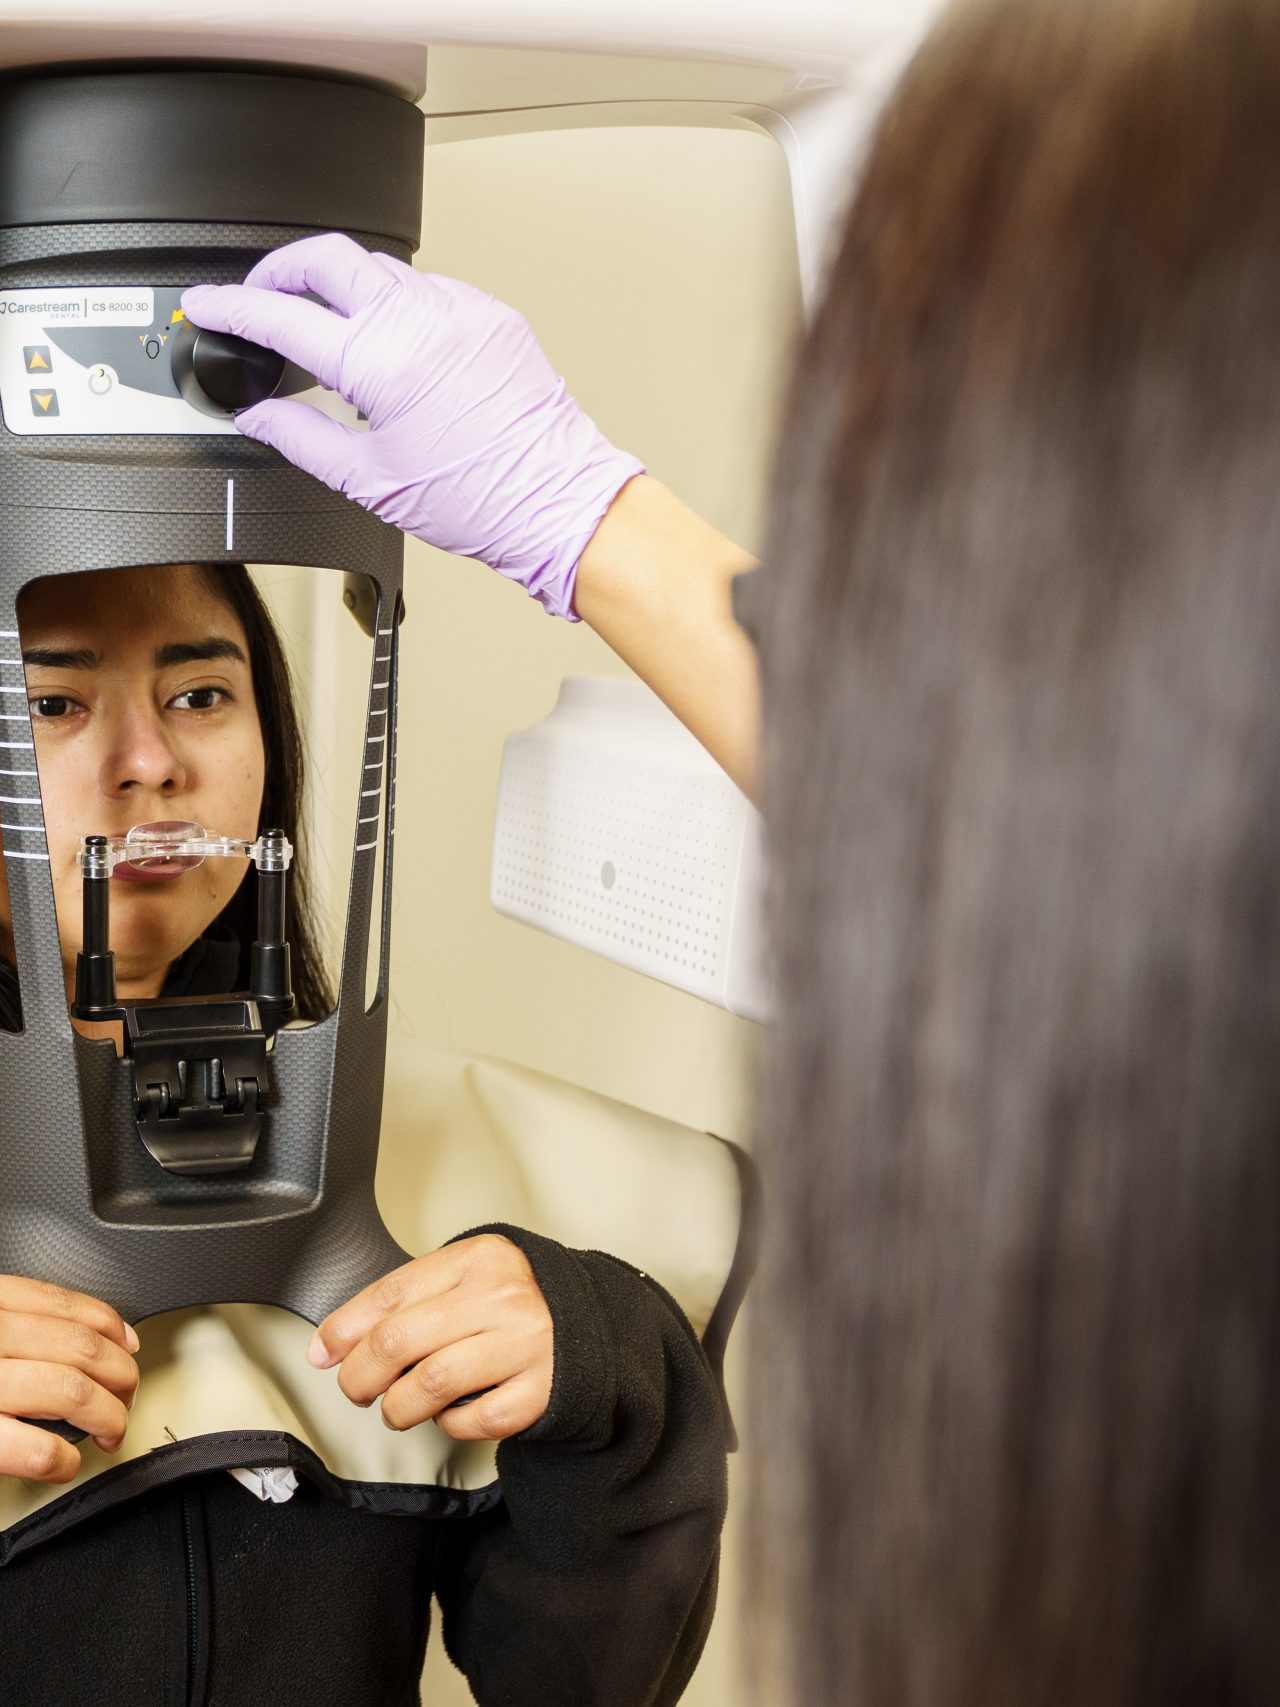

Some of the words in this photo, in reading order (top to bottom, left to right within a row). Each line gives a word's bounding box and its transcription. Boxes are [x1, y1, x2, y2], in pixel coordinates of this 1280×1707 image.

[8, 302, 80, 313] Carestream
[92, 303, 106, 311] CS
[109, 302, 132, 311] 8200
[136, 302, 148, 311] 3D
